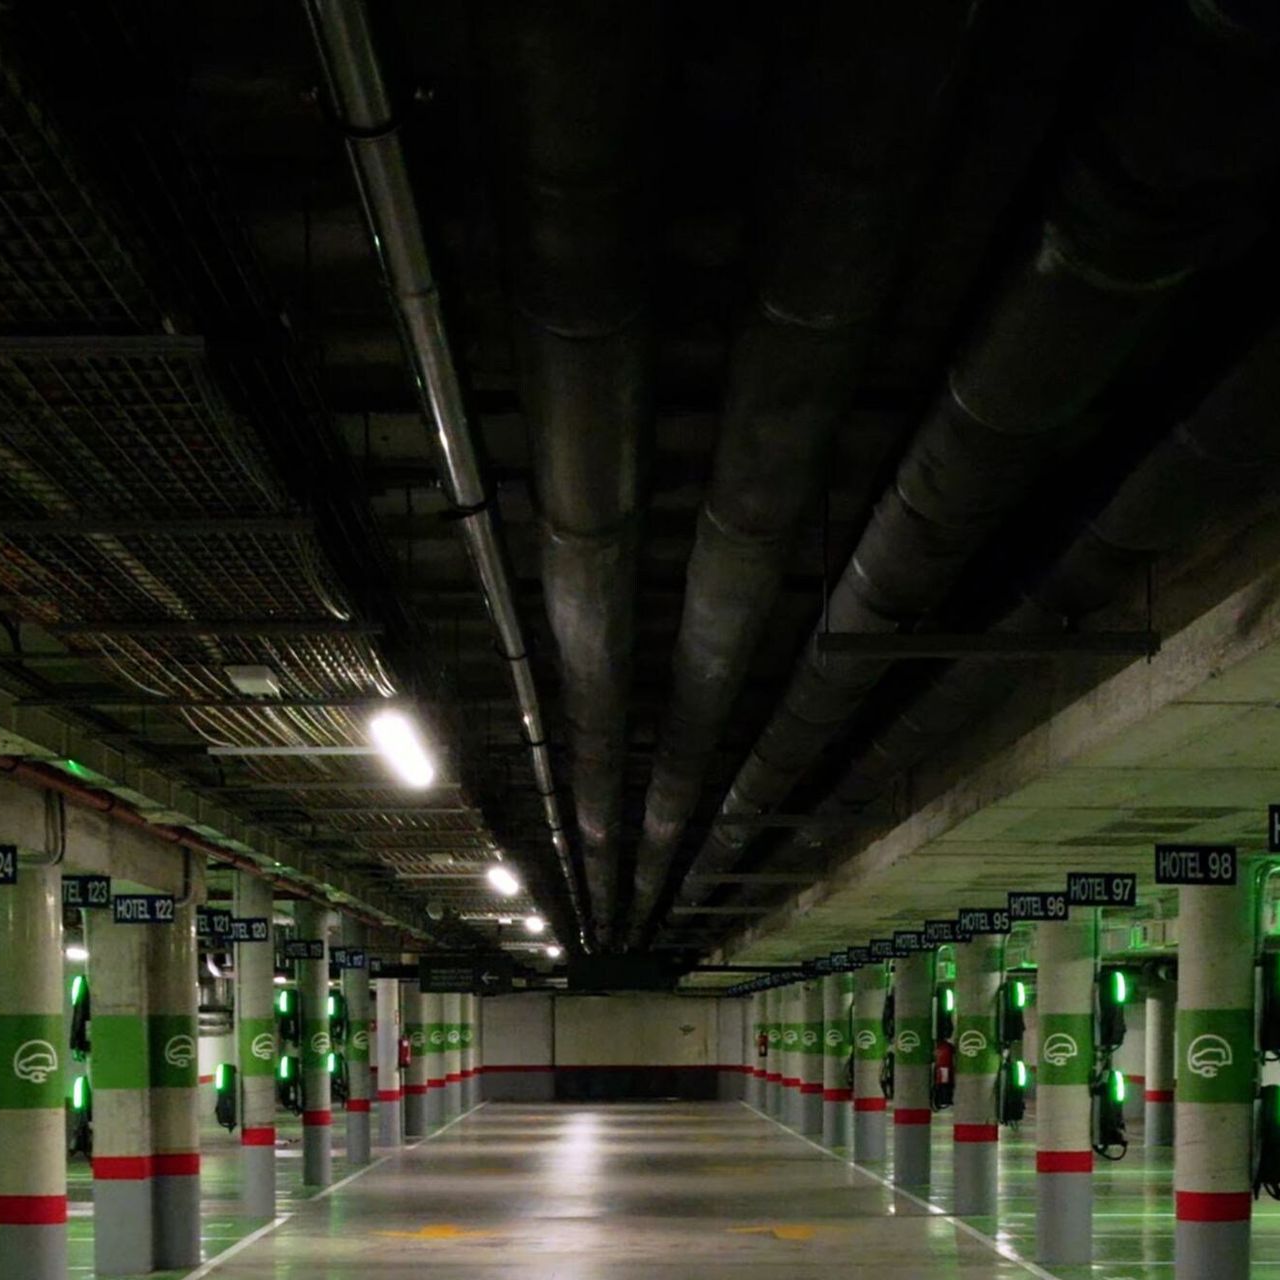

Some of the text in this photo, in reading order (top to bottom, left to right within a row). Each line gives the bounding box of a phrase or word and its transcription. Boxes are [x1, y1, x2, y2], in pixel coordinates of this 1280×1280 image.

[1159, 851, 1233, 880] HOTEL 98
[63, 880, 108, 904] TEL 123
[1070, 877, 1133, 901] HOTEL 97
[116, 898, 174, 920] HOTEL 122
[1010, 895, 1066, 917] HOTEL 96
[225, 922, 250, 939] OTEL
[926, 923, 953, 940] HOTEL
[960, 911, 1009, 931] HOTEL 95
[895, 934, 920, 950] HOTEL
